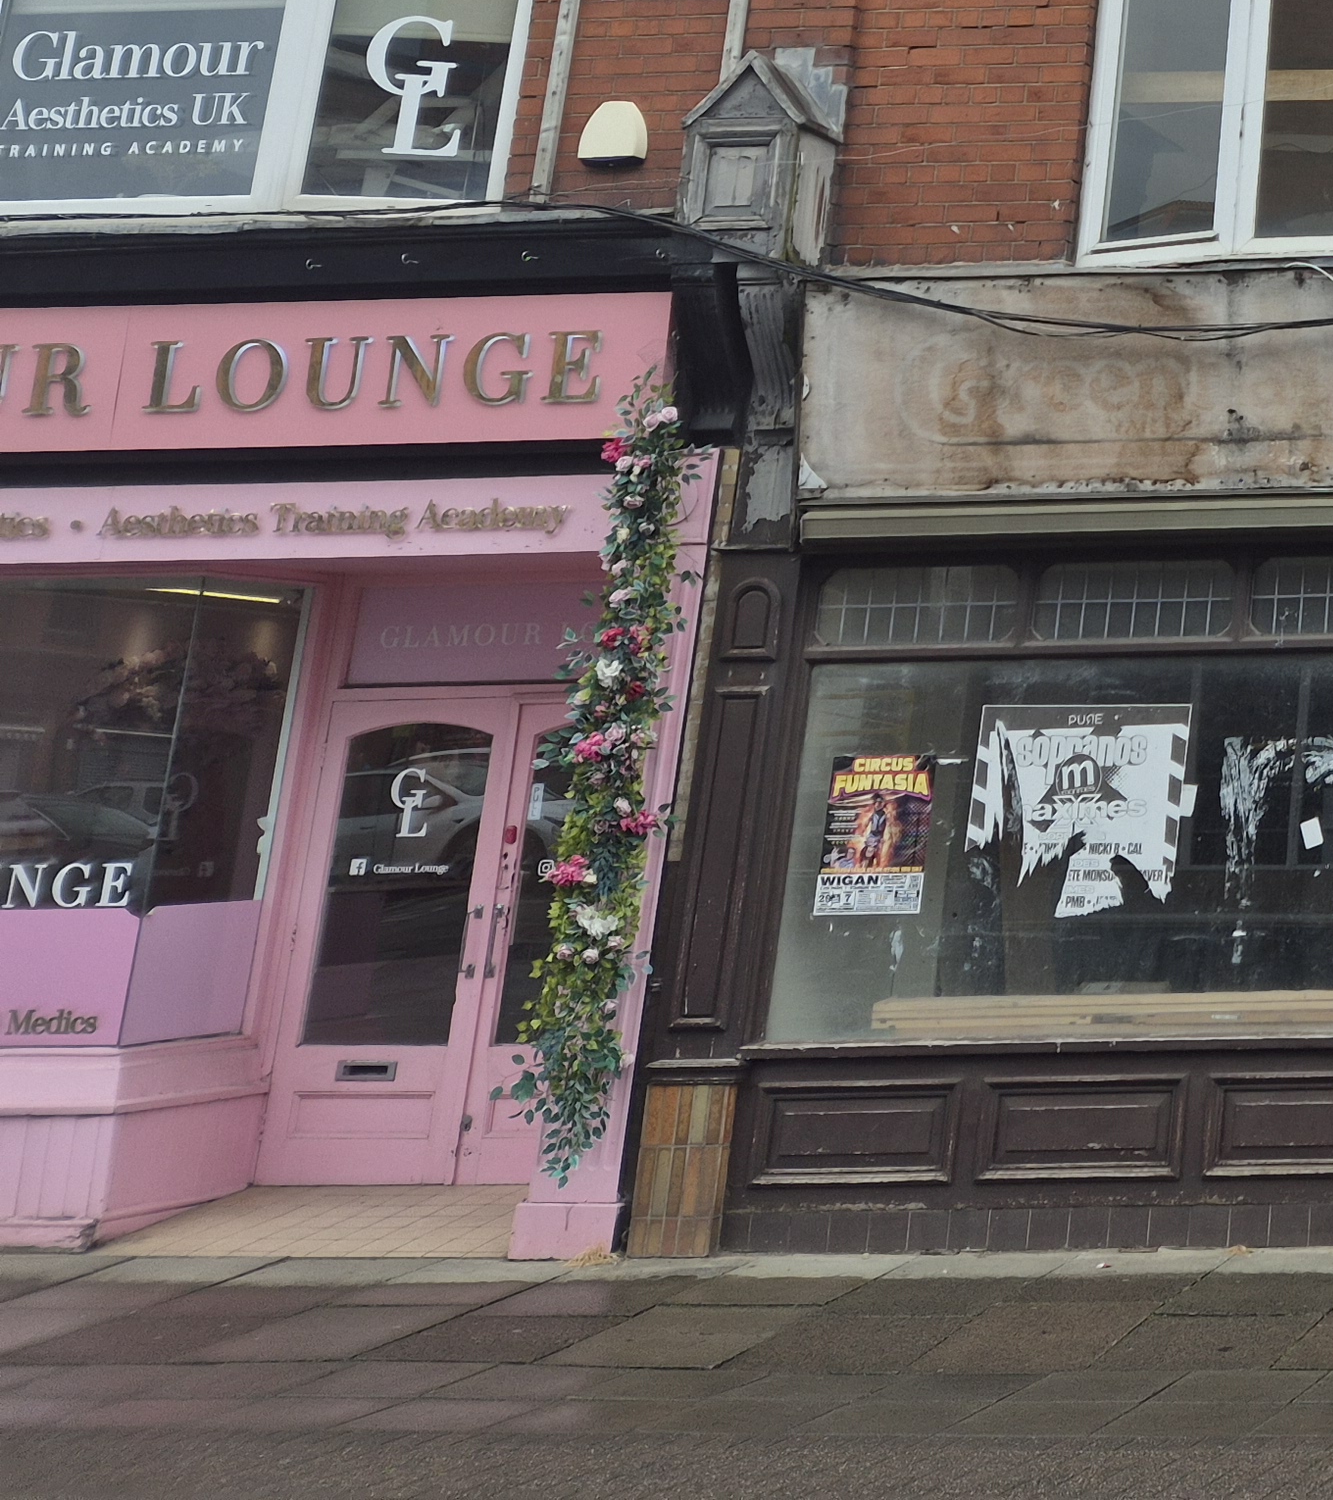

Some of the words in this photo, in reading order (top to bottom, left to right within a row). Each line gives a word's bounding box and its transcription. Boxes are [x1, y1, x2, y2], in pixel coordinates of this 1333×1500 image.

[12, 31, 264, 80] Glamour
[0, 97, 178, 130] Aesthetics
[192, 92, 250, 125] UK
[128, 139, 244, 155] ACADEMY
[142, 330, 603, 414] LOUNGE
[97, 505, 260, 537] Aesthetics
[269, 502, 409, 539] Training
[416, 498, 572, 534] Academy
[380, 623, 542, 648] GLAMOUR
[853, 757, 914, 772] CIRCUS
[832, 773, 929, 798] FUNTASIA
[373, 864, 413, 875] Glamour
[414, 862, 449, 876] Lounge
[821, 875, 879, 886] WIGAN
[4, 1009, 98, 1036] Medics
